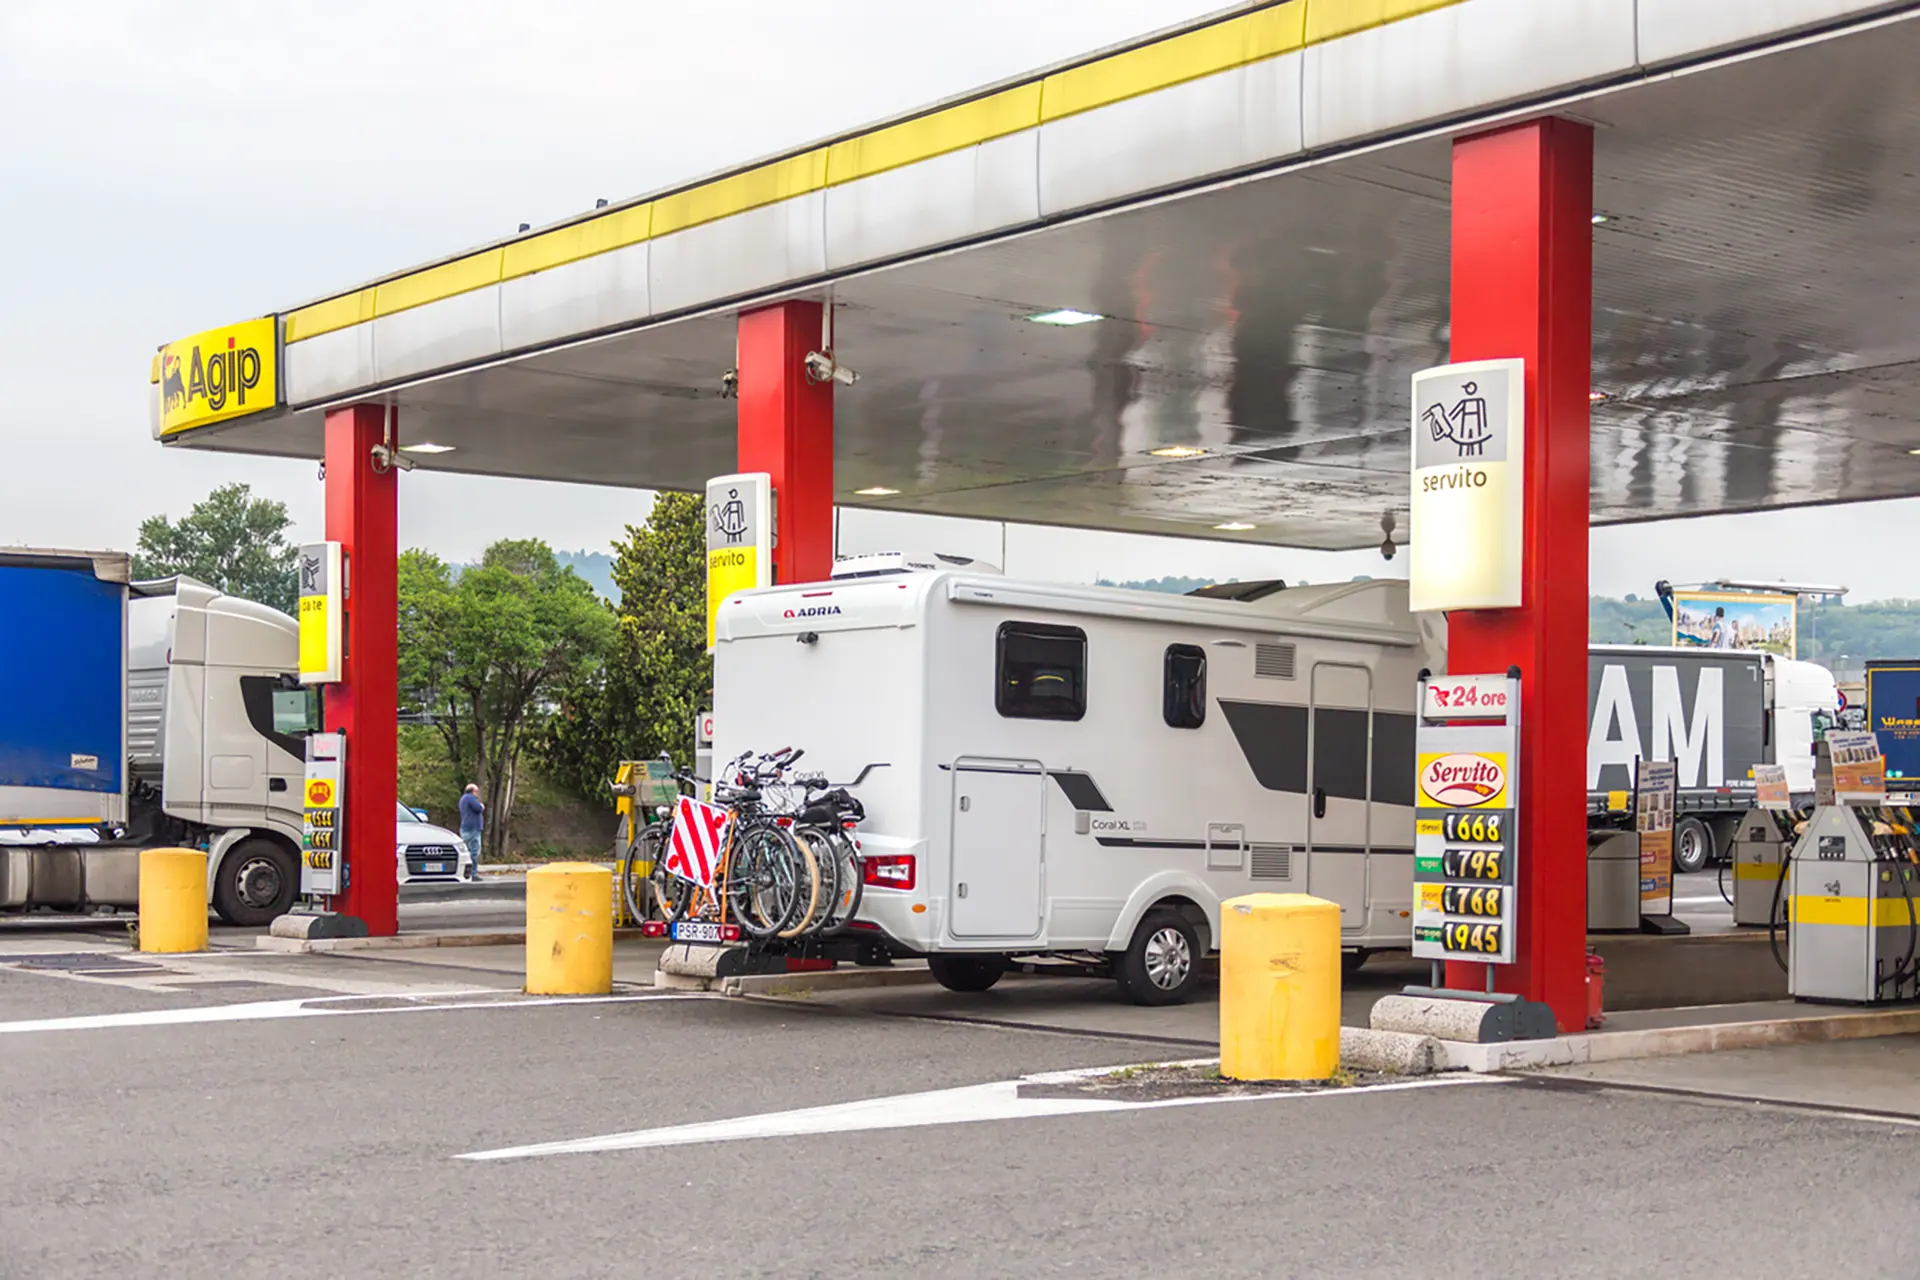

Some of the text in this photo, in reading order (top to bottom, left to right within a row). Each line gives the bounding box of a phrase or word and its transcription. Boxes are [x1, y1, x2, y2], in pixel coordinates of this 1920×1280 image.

[188, 336, 261, 411] Agip
[1422, 466, 1488, 493] servito
[797, 605, 841, 618] ADRIA
[1452, 685, 1507, 707] 24 ore
[1429, 760, 1499, 784] Servito
[1092, 819, 1118, 831] Coral
[1118, 820, 1131, 831] XL
[678, 924, 718, 940] PSR-907
